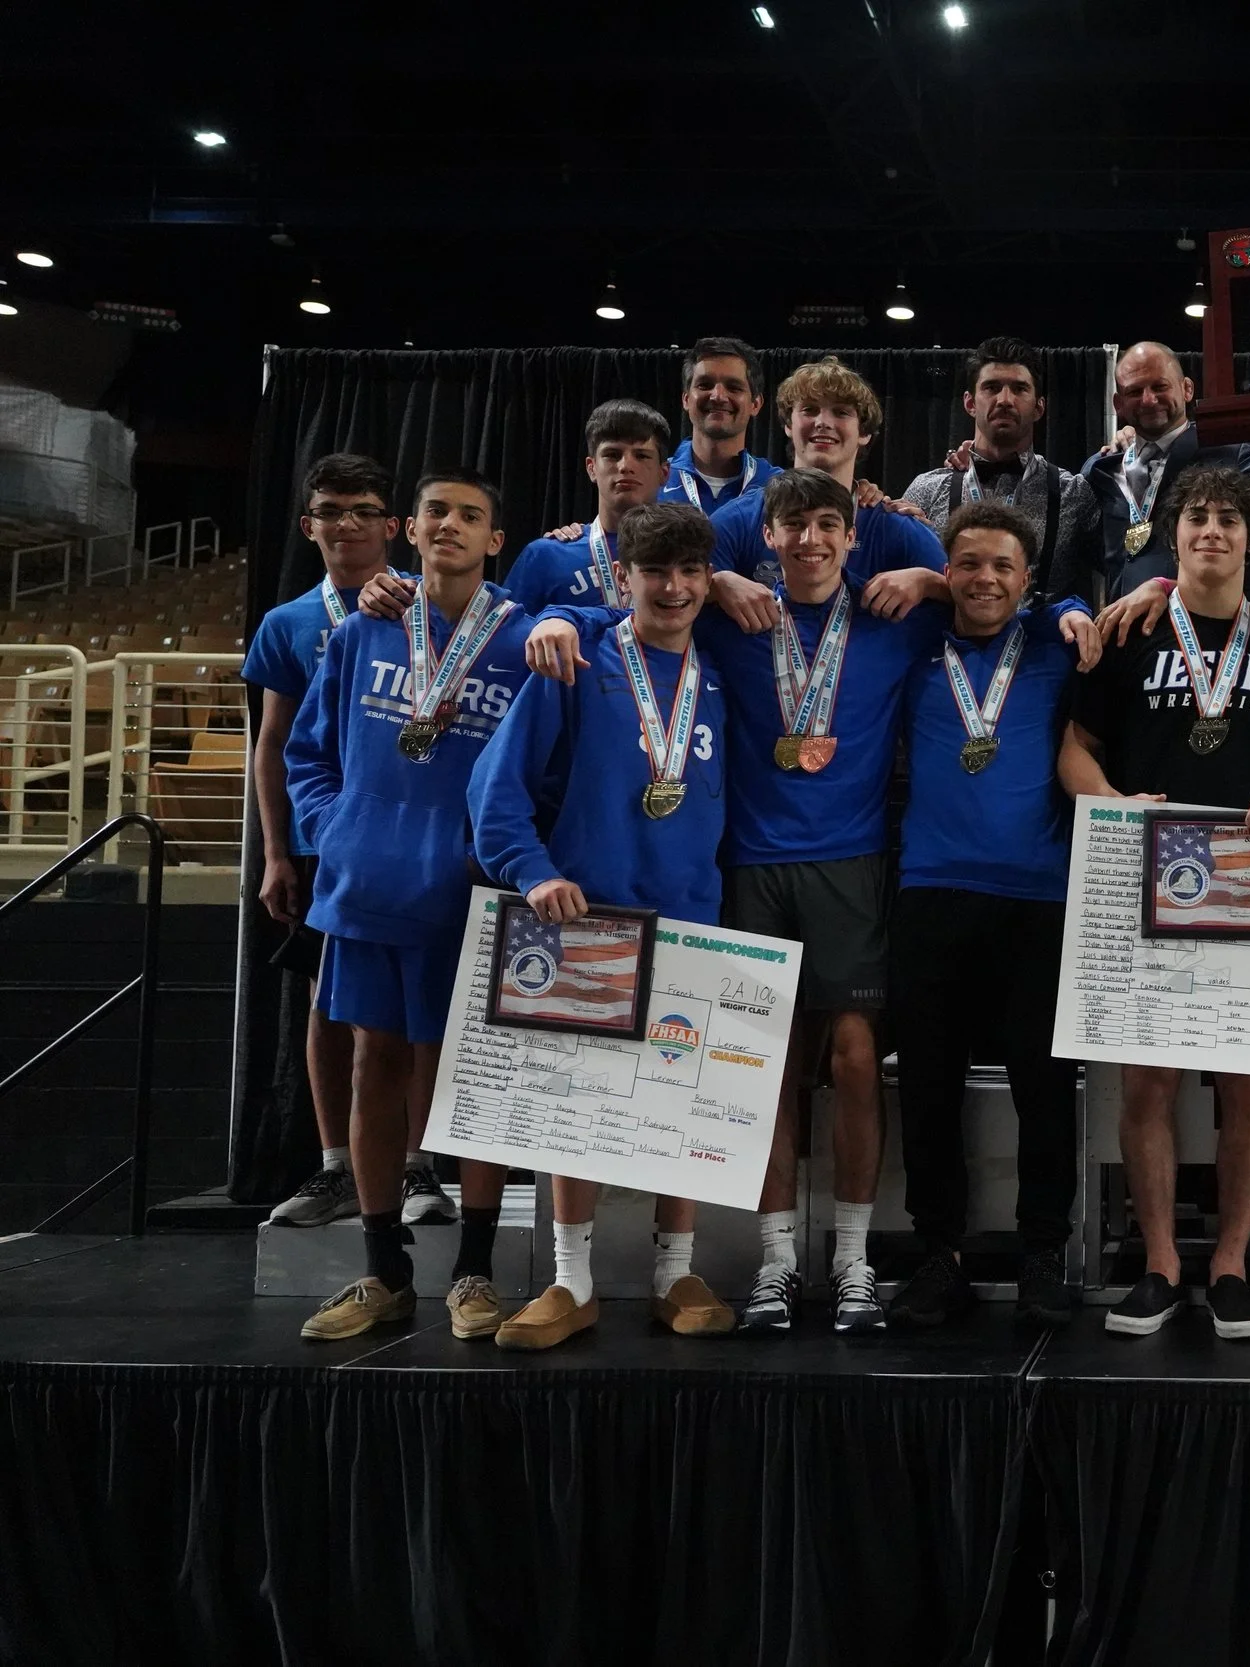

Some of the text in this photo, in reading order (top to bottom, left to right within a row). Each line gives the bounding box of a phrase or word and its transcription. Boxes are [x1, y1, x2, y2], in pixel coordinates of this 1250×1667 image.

[105, 302, 166, 316] SECTIONS
[595, 541, 614, 591] WRESTLING
[466, 612, 499, 658] WRESTLING
[1174, 608, 1197, 656] WRESTLING
[436, 634, 467, 688] WRESTLING
[1224, 630, 1246, 679] WRESTLING
[627, 646, 650, 704] WRESTLING
[952, 665, 973, 713] WRESTLING
[365, 711, 403, 724] JESUIT HIGH
[677, 688, 693, 745] WRESTLING
[463, 731, 490, 741] FLORIDA
[1089, 808, 1123, 822] 2022
[1162, 826, 1195, 835] National
[1198, 827, 1235, 837] Wrestling
[588, 921, 605, 929] Hall
[617, 923, 638, 932] Fame
[603, 931, 637, 940] Museum
[682, 934, 788, 964] CHAMPIONSHIPS
[668, 983, 695, 998] French
[720, 977, 777, 1005] 2A 106
[719, 1001, 770, 1017] WEIGHT CLASS
[524, 1033, 558, 1050] Williams
[650, 1025, 698, 1045] FHSAA
[709, 1050, 765, 1069] CHAMPION
[691, 1106, 720, 1120] Williams
[727, 1102, 758, 1121] Williams
[596, 1130, 625, 1143] Williams
[689, 1150, 727, 1163] 3rd Place
